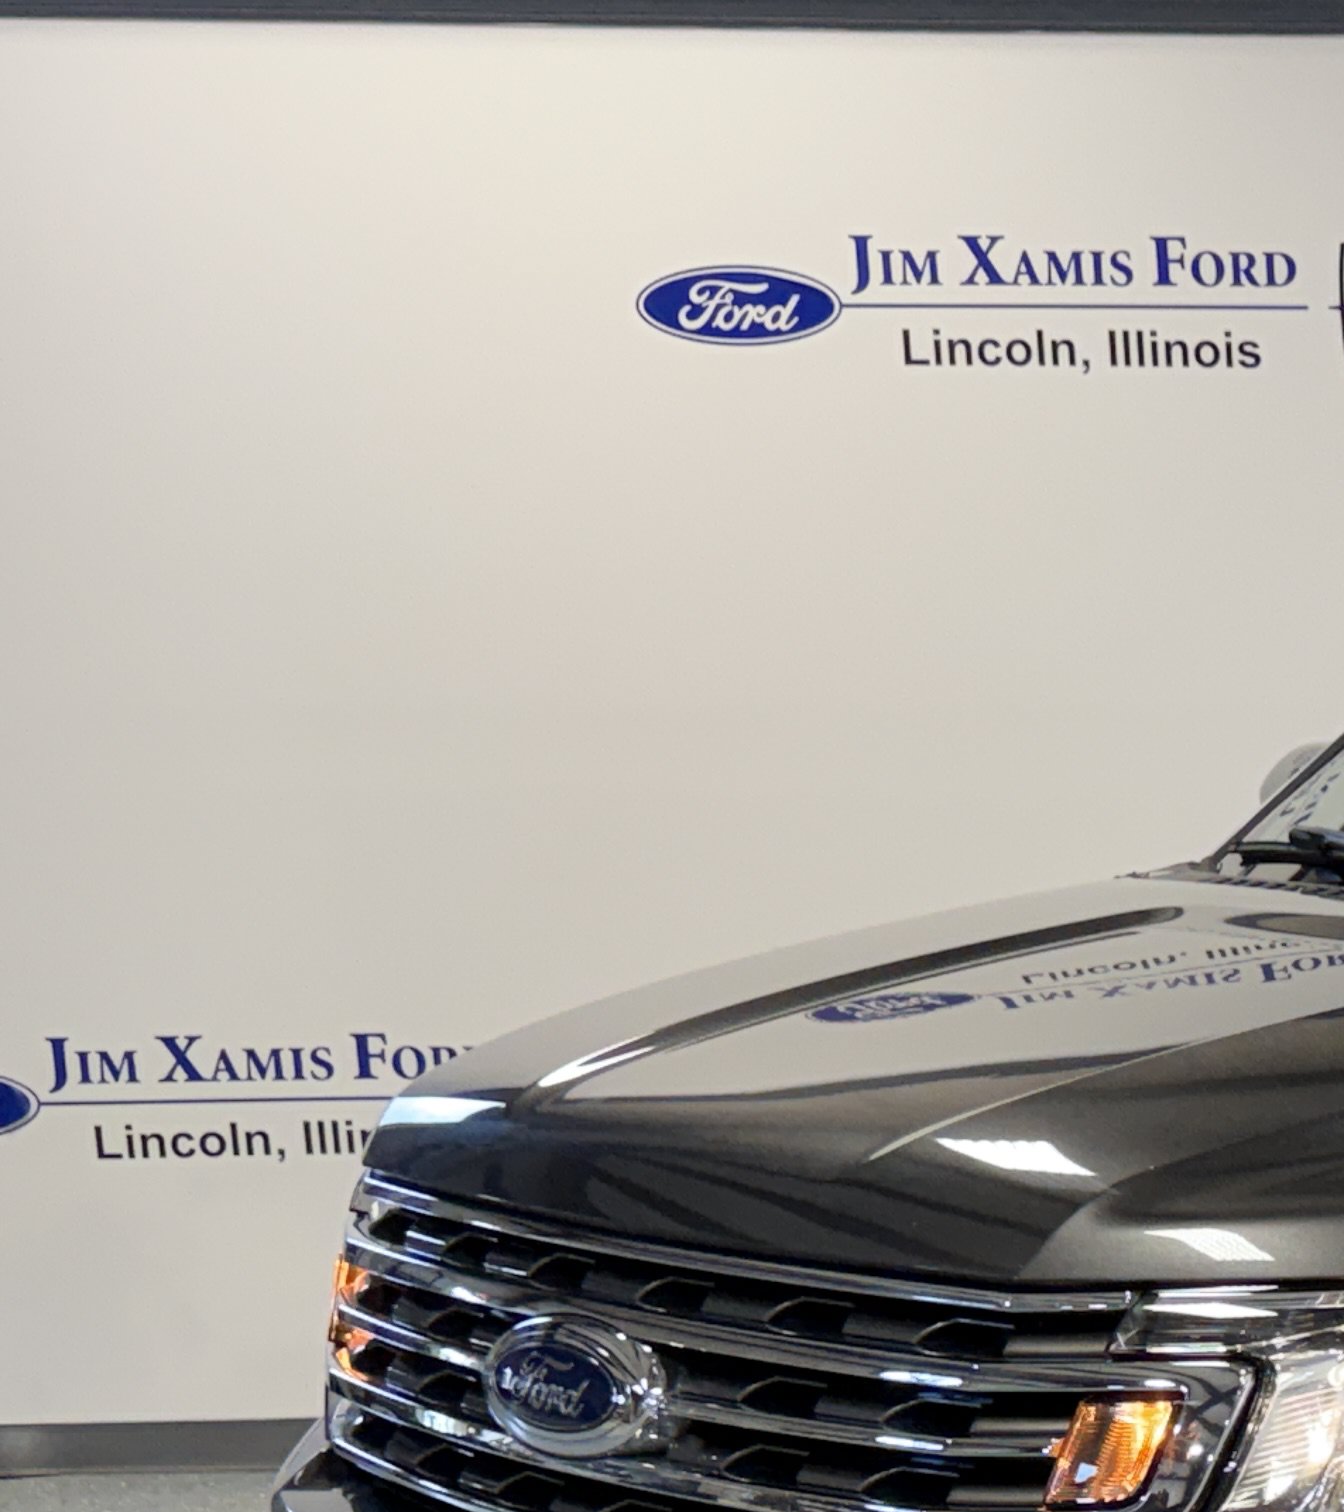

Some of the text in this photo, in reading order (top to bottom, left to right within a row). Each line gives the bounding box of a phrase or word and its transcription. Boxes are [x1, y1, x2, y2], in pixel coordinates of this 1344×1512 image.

[848, 234, 1297, 294] JIM XAMIS FORD
[678, 278, 800, 331] Ford
[902, 328, 1262, 374] Lincoln, Illinois
[45, 1032, 473, 1094] JIM XAMIS FOR
[94, 1122, 286, 1162] Lincoln,
